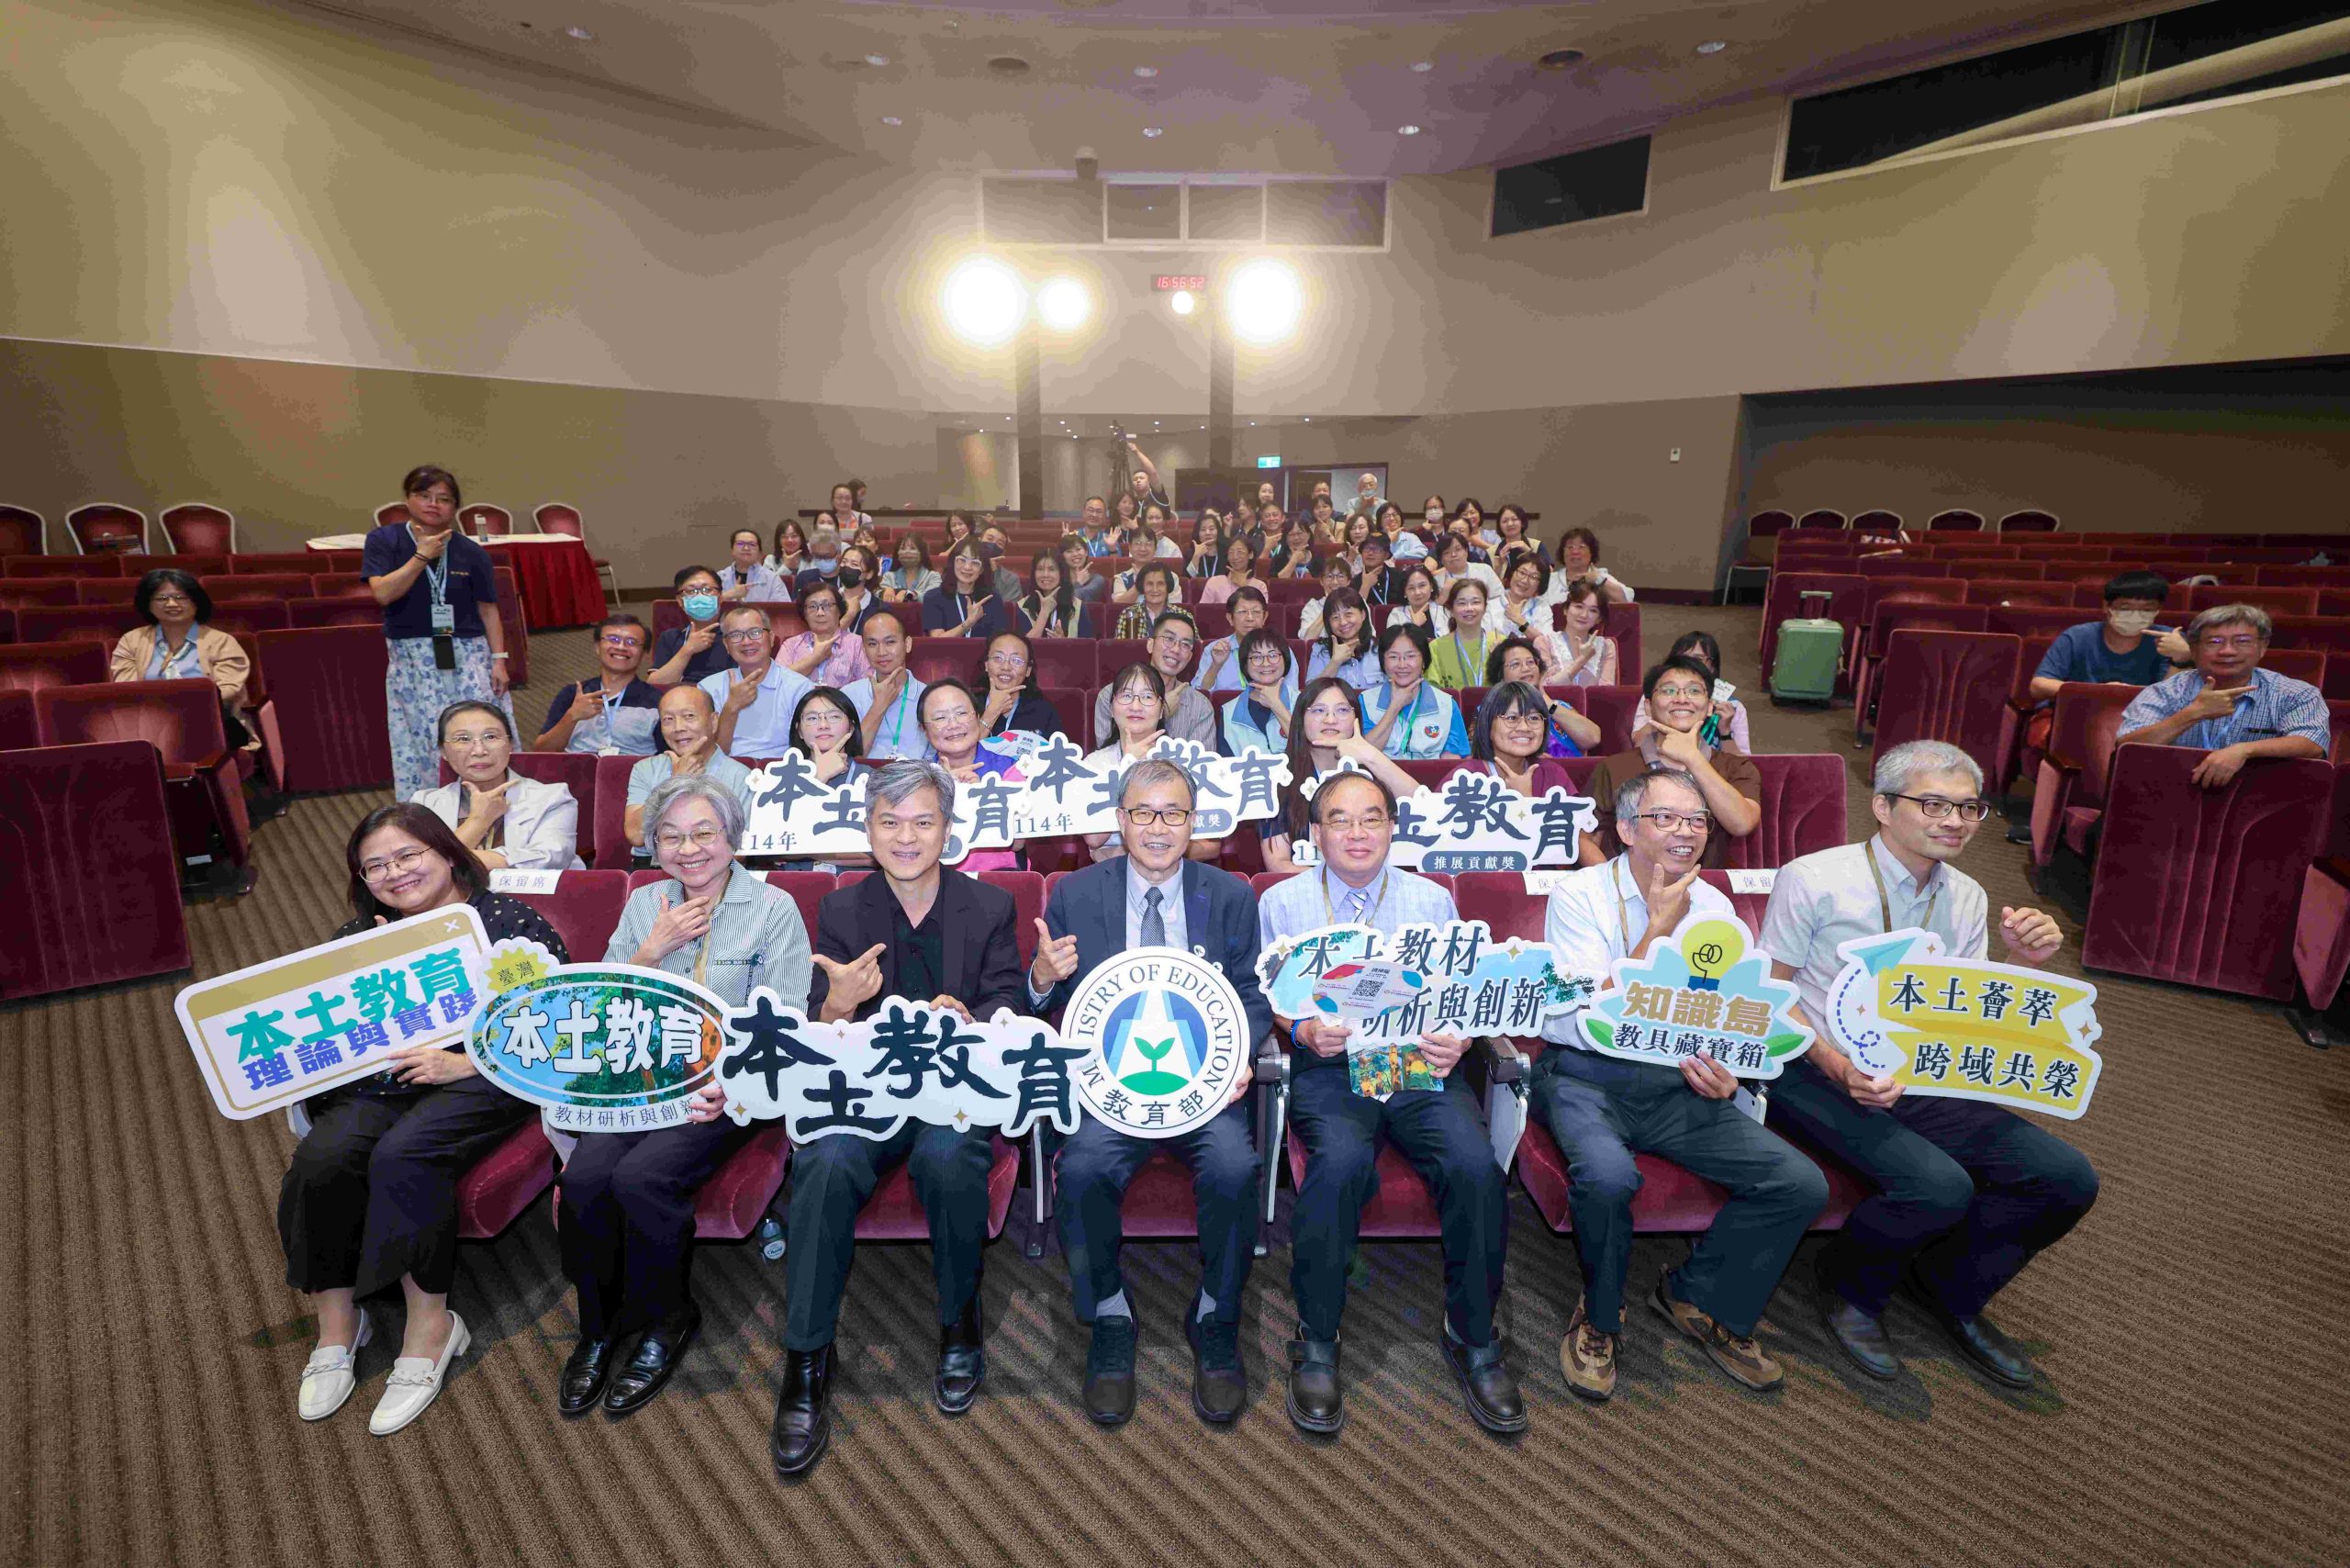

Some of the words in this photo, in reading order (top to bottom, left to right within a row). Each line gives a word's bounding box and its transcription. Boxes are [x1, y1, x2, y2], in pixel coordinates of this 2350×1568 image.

[757, 753, 1023, 843] 本土育
[1014, 812, 1073, 834] 114年
[1342, 763, 1590, 860] 土教育
[1434, 856, 1516, 870] 推展貢獻獎
[498, 959, 535, 987] 臺灣
[1889, 974, 2057, 1027] 本土薈萃
[226, 947, 470, 1064] 本土教育
[1078, 973, 1125, 1089] MISTRY
[1129, 964, 1160, 984] OF
[1167, 966, 1234, 1092] EDUCATION
[1623, 981, 1772, 1036] 知識島
[242, 987, 478, 1091] 理論與實踐
[501, 996, 705, 1075] 本土教育
[1615, 1023, 1766, 1069] 教具藏寶箱
[722, 996, 1092, 1132] 本土教育
[1914, 1043, 2079, 1098] 跨域共榮
[1102, 1089, 1203, 1126] 教育部
